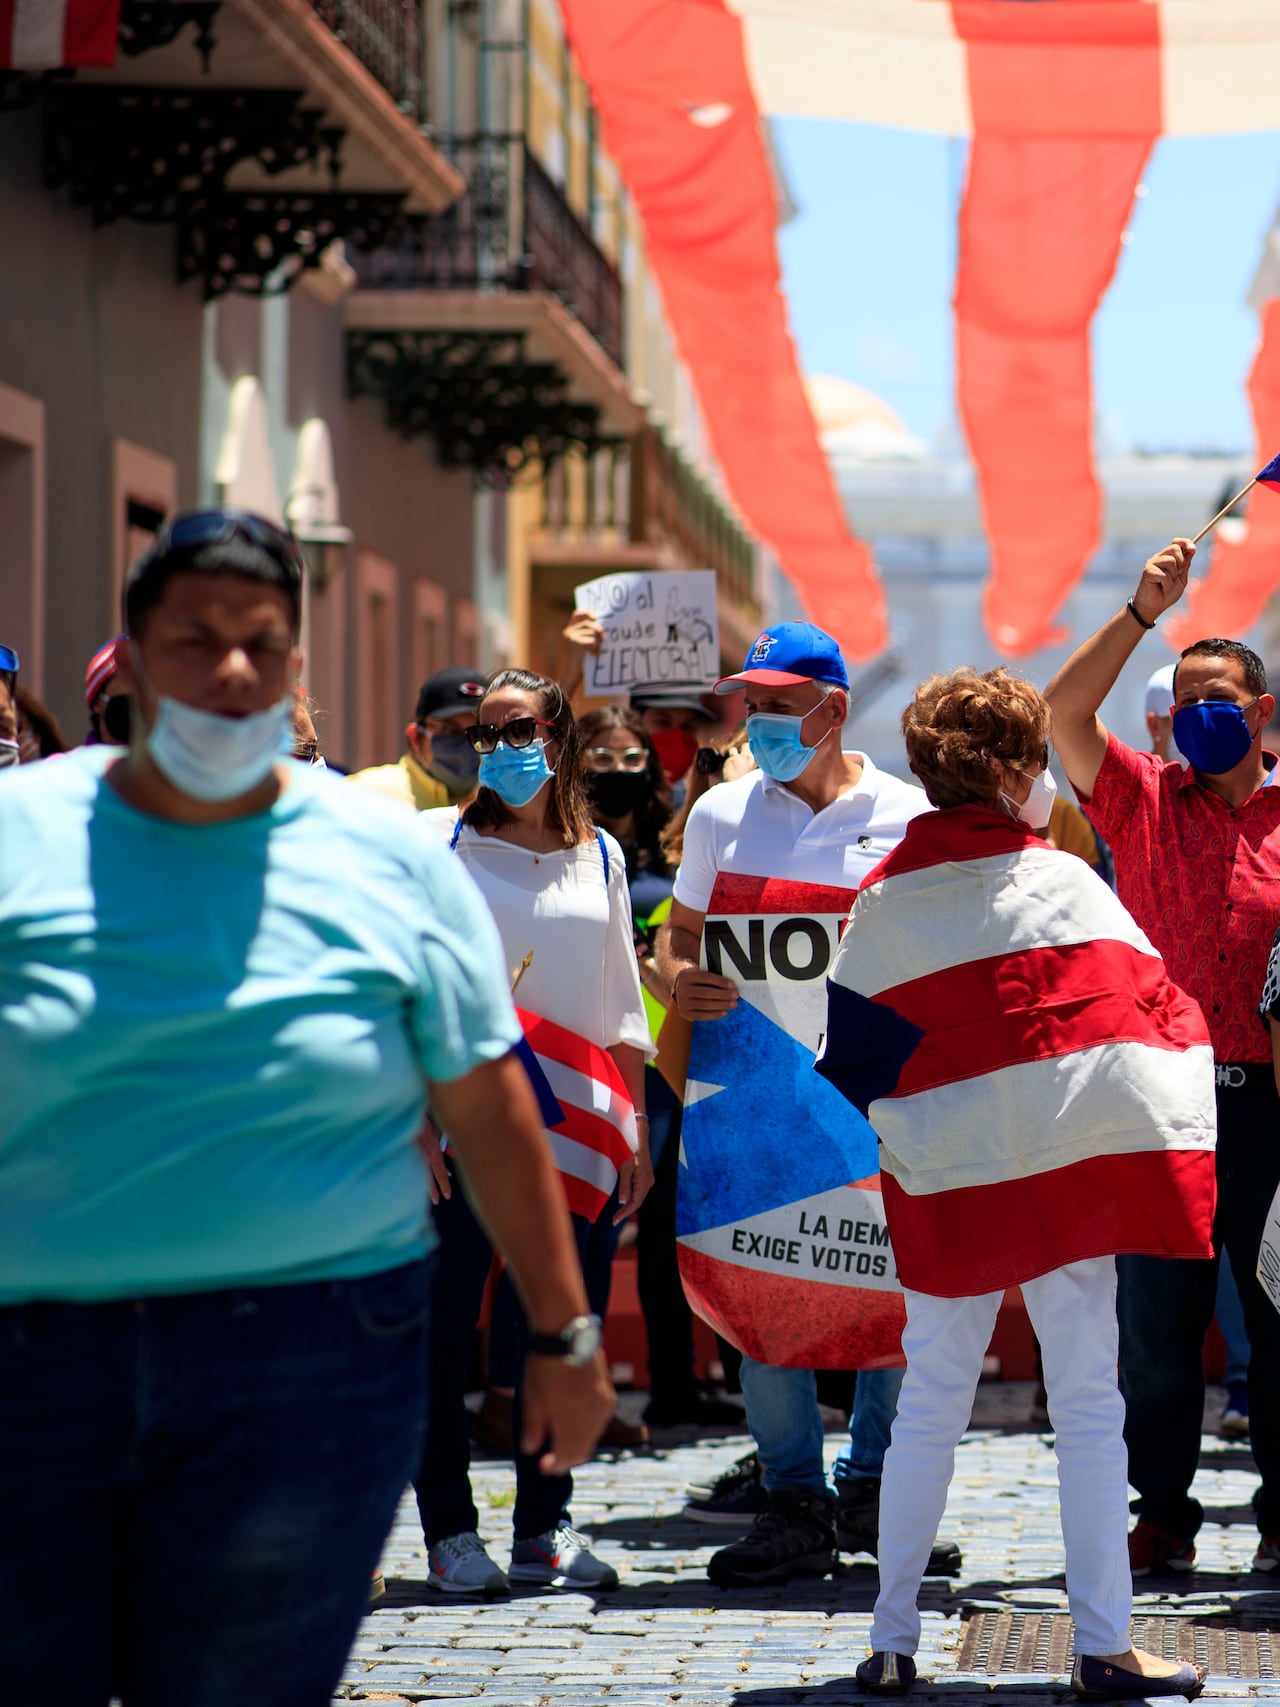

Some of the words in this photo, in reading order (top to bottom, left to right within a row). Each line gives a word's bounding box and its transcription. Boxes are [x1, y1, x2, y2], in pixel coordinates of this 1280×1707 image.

[799, 1211, 829, 1238] LA
[731, 1228, 802, 1265] EXIGE
[811, 1244, 888, 1278] VOTOS
